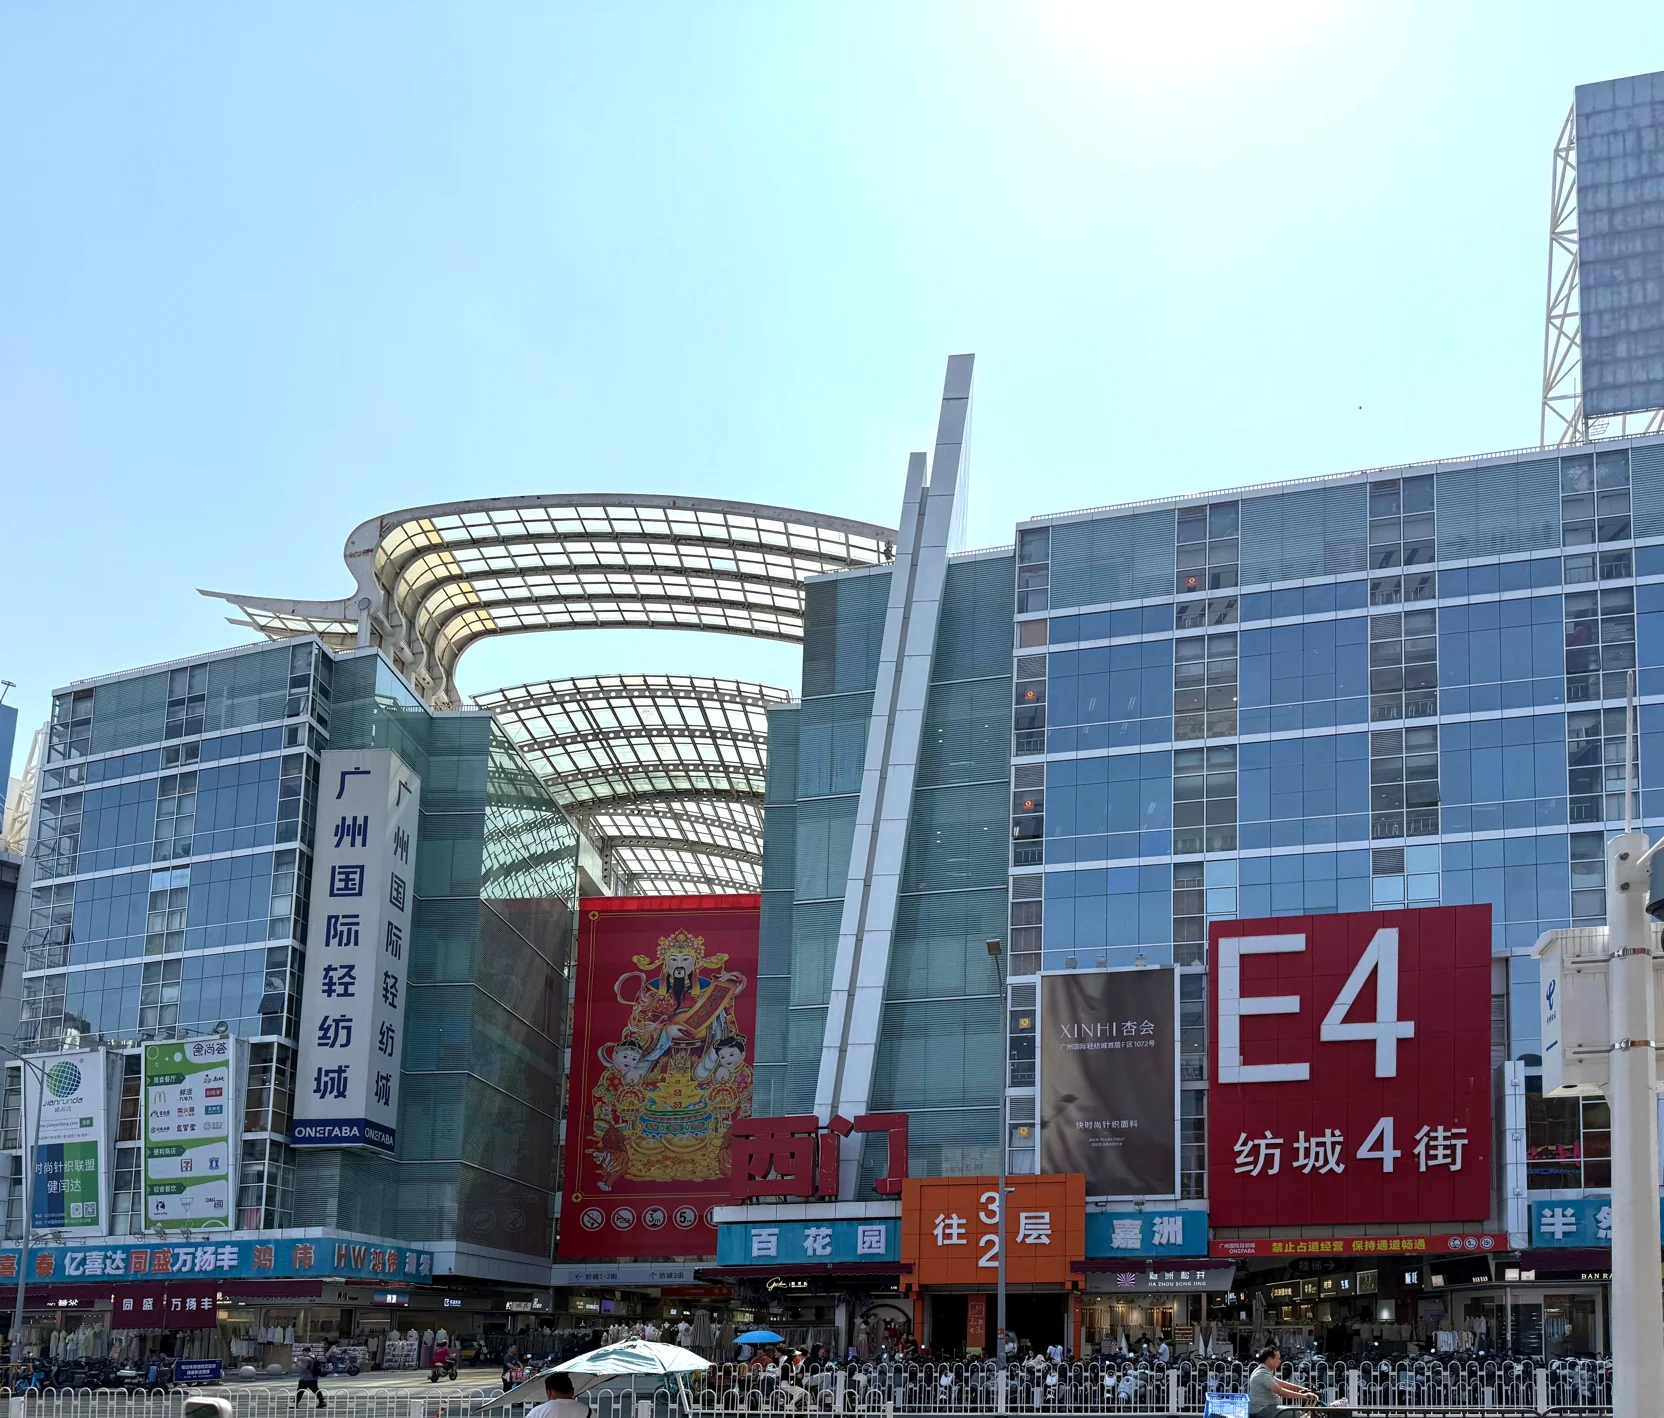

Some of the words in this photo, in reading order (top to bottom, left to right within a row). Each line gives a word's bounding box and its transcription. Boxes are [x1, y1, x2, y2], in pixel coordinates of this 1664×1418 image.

[313, 766, 371, 1100] 广州国际轻纺城
[375, 781, 412, 1108] 广州国际轻纺城
[1218, 927, 1415, 1083] E4
[1060, 1022, 1117, 1039] XINHI
[1121, 1019, 1155, 1037] 杏会
[1075, 1120, 1138, 1130] 快时尚针织面料
[153, 1147, 176, 1156] 便利商店
[730, 1113, 909, 1199] 西门
[1233, 1116, 1468, 1177] 纺城4街
[35, 1158, 95, 1174] 时尚针织联盟
[751, 1225, 887, 1258] 百花园
[933, 1213, 967, 1246] 往
[1016, 1212, 1052, 1245] 层
[1110, 1216, 1183, 1250] 嘉洲
[172, 1245, 239, 1273] 万扬丰
[252, 1243, 314, 1270] 鸿伟
[334, 1243, 367, 1269] HW
[370, 1247, 398, 1273] 鸿伟
[1272, 1241, 1344, 1253] 禁止占道经营
[1352, 1238, 1426, 1251] 保持通道畅通
[64, 1250, 127, 1276] 亿喜达
[129, 1248, 172, 1274] 同盛
[122, 1297, 154, 1311] 同盛
[171, 1297, 213, 1312] 万扬丰
